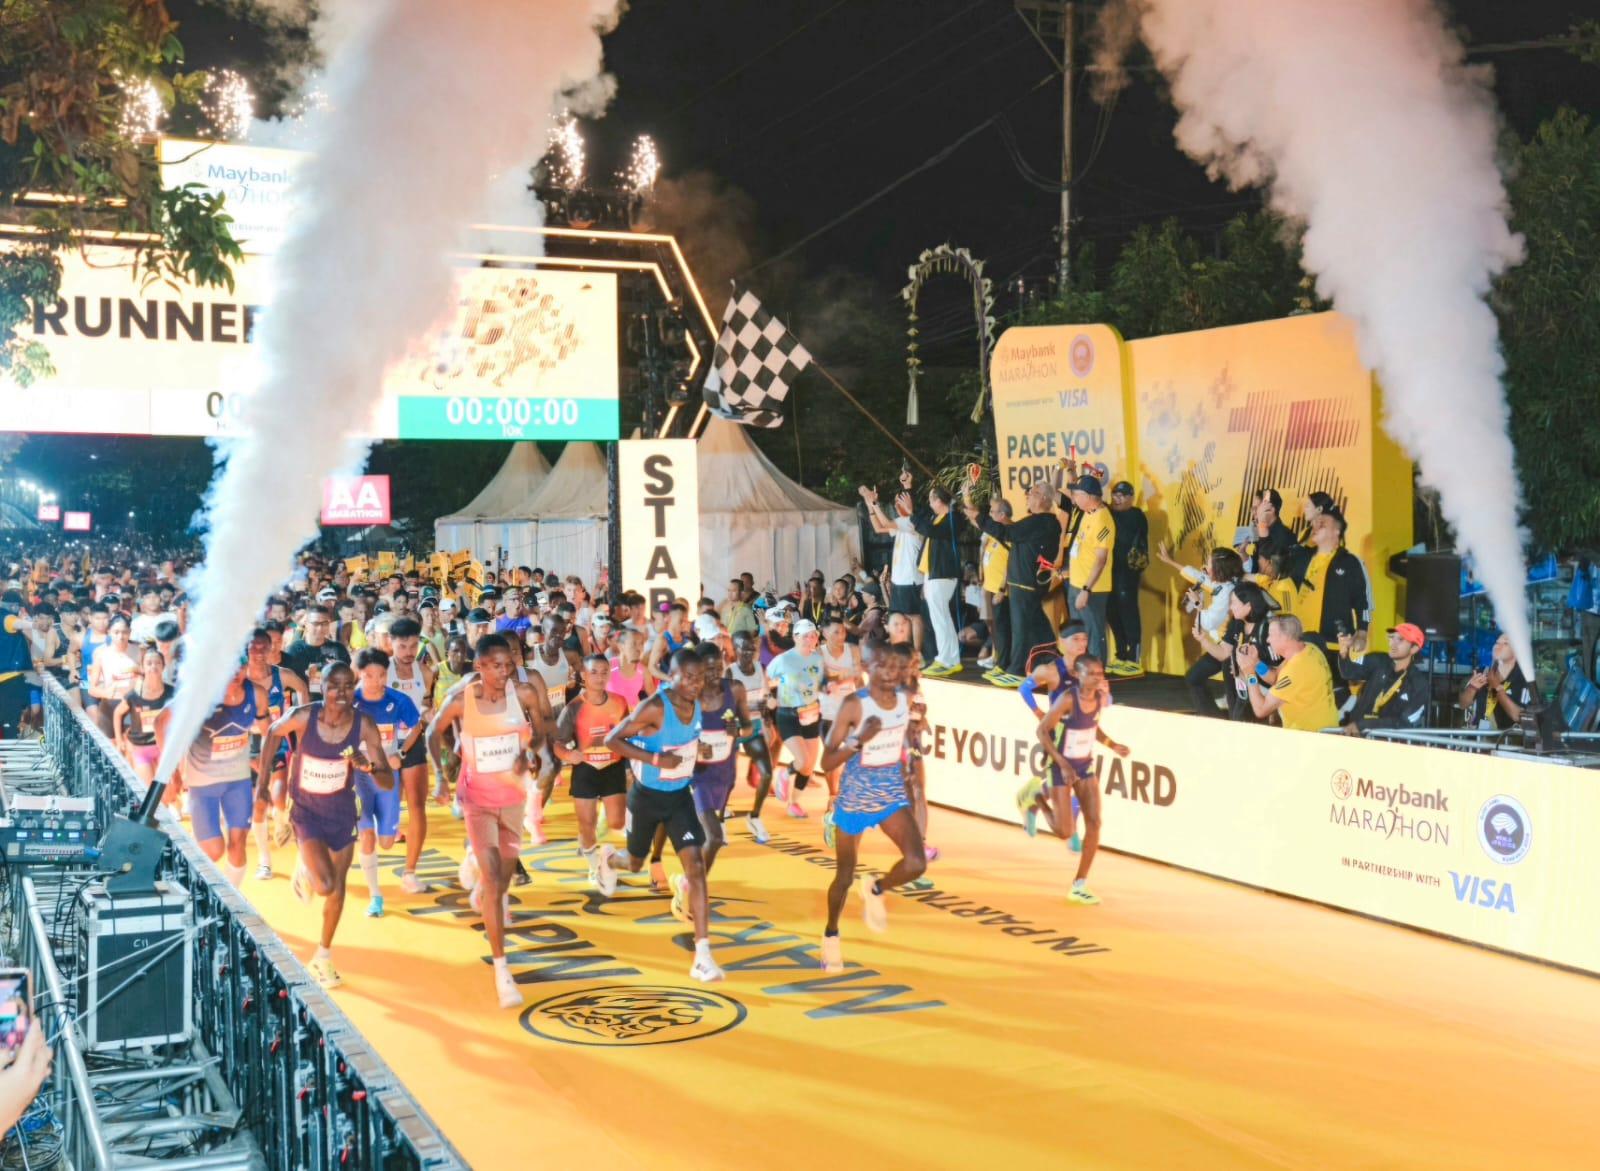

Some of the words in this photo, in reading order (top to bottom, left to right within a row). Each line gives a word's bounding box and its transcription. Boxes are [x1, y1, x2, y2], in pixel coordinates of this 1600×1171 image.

[1011, 344, 1056, 362] Maybank
[999, 361, 1057, 383] MARATHON
[446, 397, 579, 425] 00:00:00
[1058, 388, 1089, 408] VISA
[502, 425, 524, 437] 10K
[1007, 432, 1057, 459] PACE
[1061, 428, 1105, 457] YOU
[952, 727, 1007, 772] YOU
[1356, 778, 1449, 812] Maybank
[1329, 803, 1449, 846] MARATHON
[1341, 857, 1351, 868] IN
[1352, 858, 1413, 881] PARTNERSHIP
[1415, 872, 1441, 887] WITH
[1447, 870, 1516, 914] VISA
[1032, 931, 1112, 957] IN
